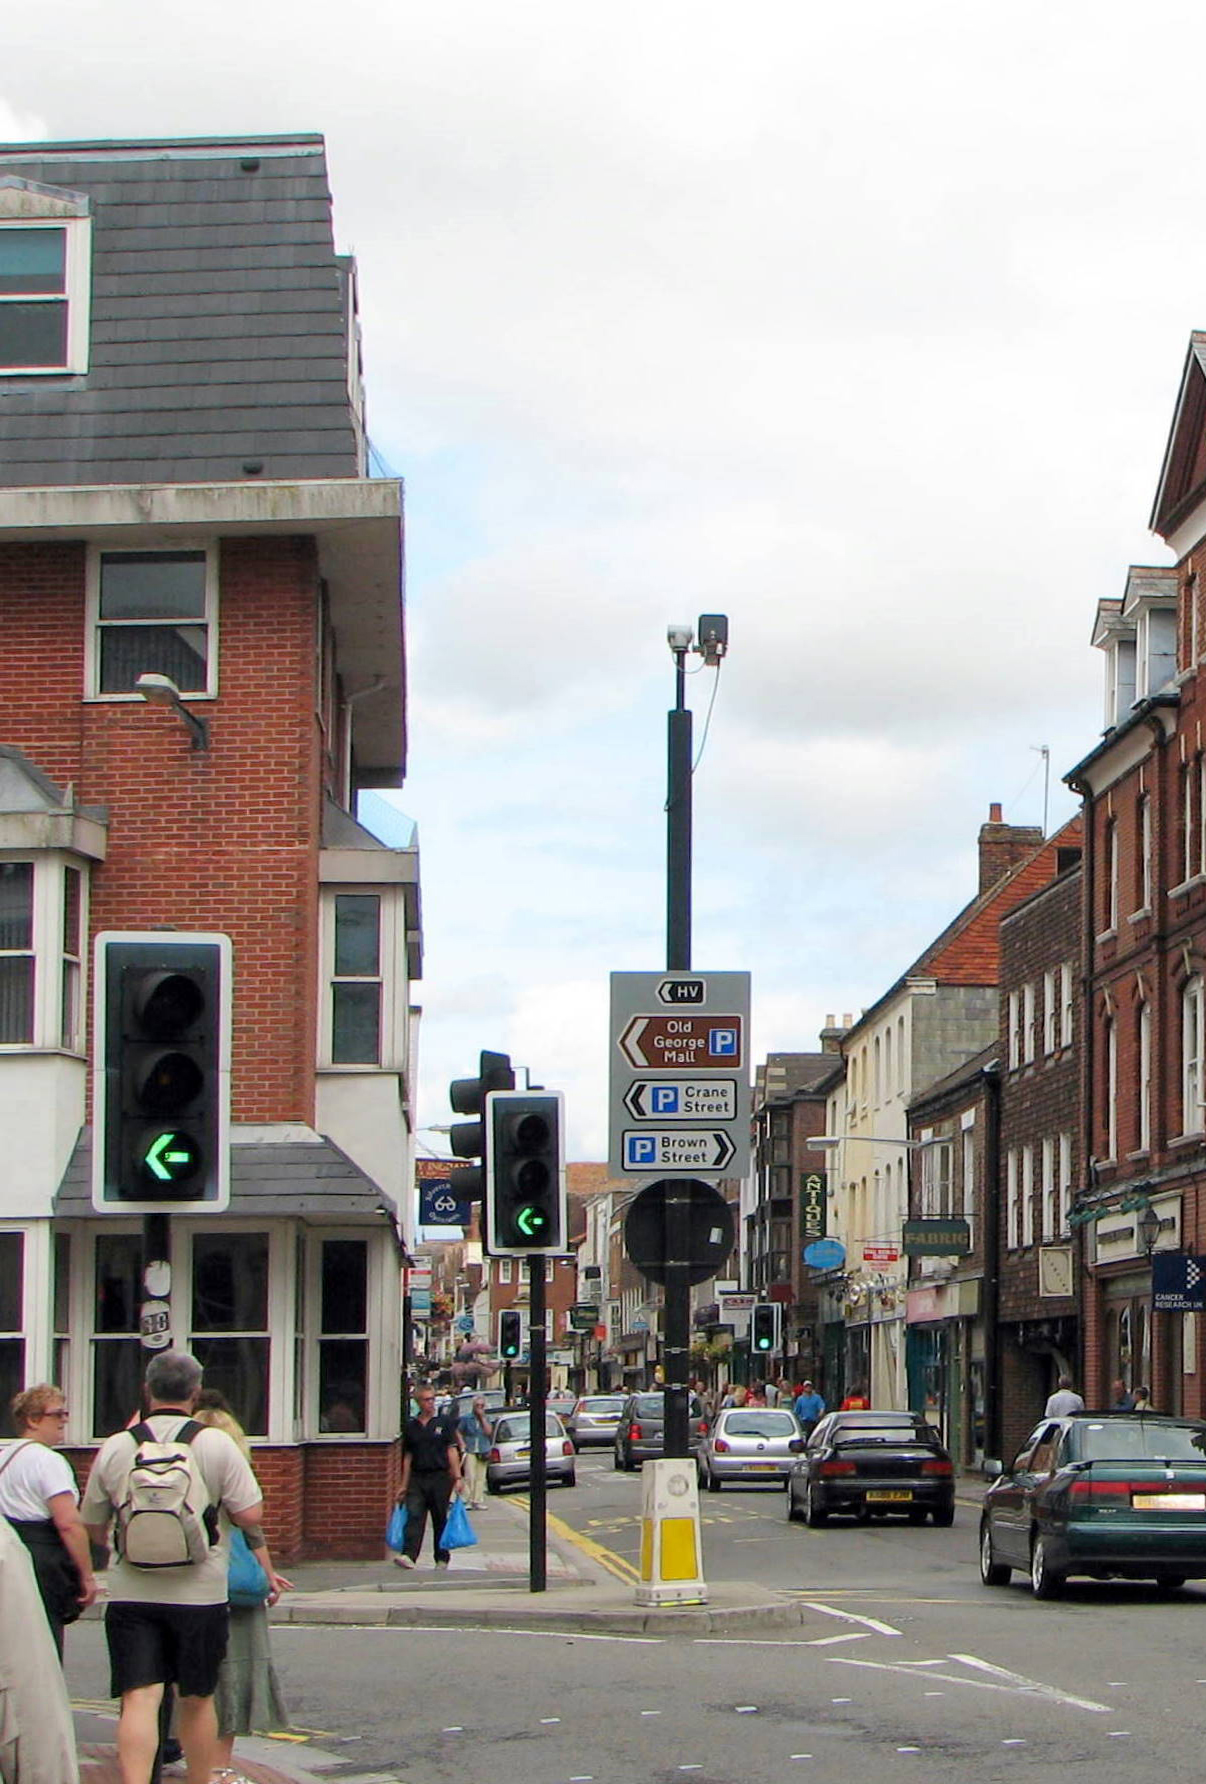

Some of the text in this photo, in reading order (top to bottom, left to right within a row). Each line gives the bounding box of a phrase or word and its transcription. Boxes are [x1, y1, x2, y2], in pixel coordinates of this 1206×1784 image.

[677, 985, 699, 998] HV
[667, 1020, 692, 1032] Old
[654, 1036, 705, 1050] George
[716, 1032, 732, 1052] P
[664, 1051, 696, 1063] Mall
[685, 1087, 728, 1098] Crane
[658, 1090, 674, 1111] P
[684, 1100, 730, 1112] Street
[661, 1137, 708, 1148] Brown
[634, 1140, 651, 1161] P
[661, 1151, 707, 1163] Street
[805, 1174, 822, 1237] ANTIQUES
